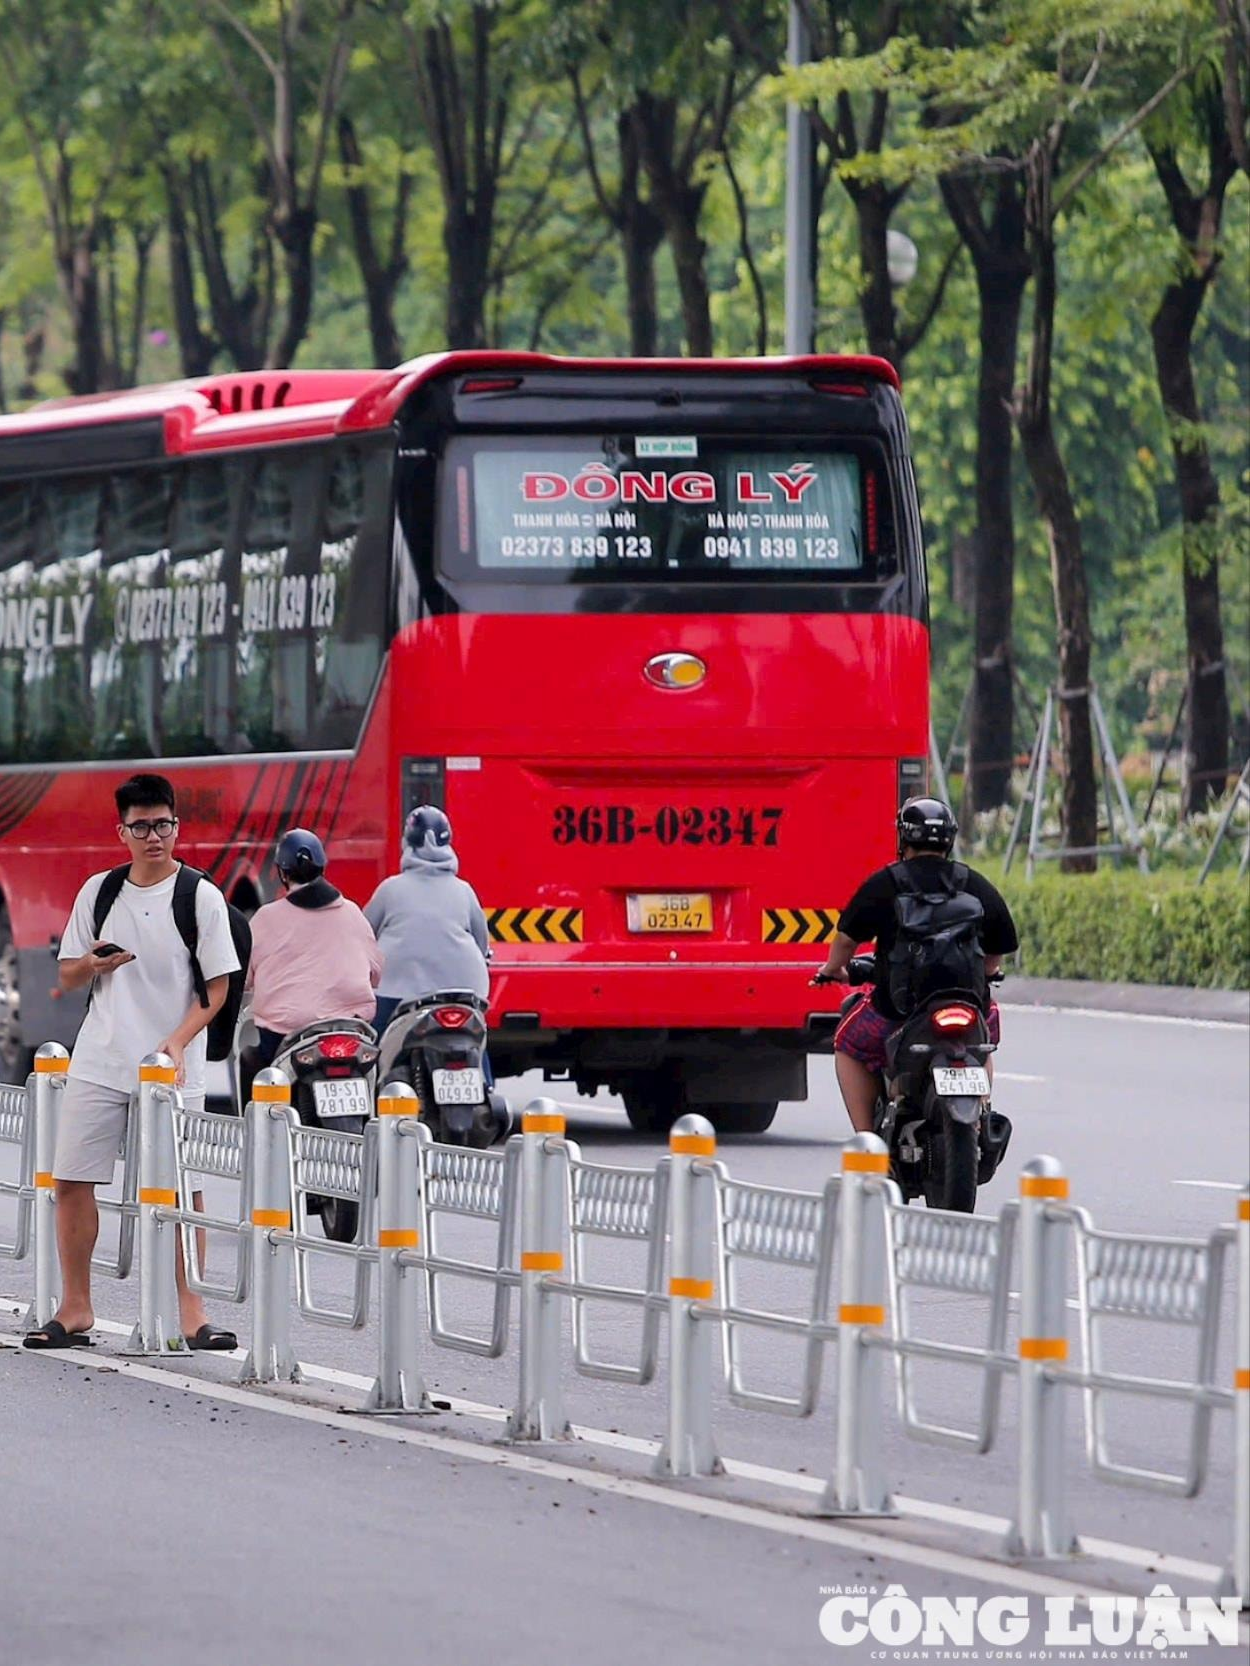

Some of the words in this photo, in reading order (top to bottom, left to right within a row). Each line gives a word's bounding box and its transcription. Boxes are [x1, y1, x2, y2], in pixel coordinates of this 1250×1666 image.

[519, 462, 716, 503] ĐÔNG
[737, 463, 818, 503] LÝ
[513, 513, 553, 528] THANH
[596, 510, 612, 528] HÀ
[614, 510, 636, 530] NỘI
[707, 511, 724, 529] HÀ
[727, 511, 748, 530] NỘI
[764, 513, 803, 529] THANH
[501, 535, 564, 557] 02373
[571, 536, 609, 558] 839
[614, 536, 652, 558] 123
[704, 536, 751, 558] 0941
[760, 537, 797, 559] 839
[804, 537, 839, 559] 123
[202, 581, 226, 635] 123
[278, 574, 307, 630] 839
[311, 572, 336, 627] 123
[553, 806, 783, 846] 36B-02347
[660, 896, 690, 911] 36B
[647, 913, 703, 928] 023.47
[320, 1097, 368, 1113] 281.99
